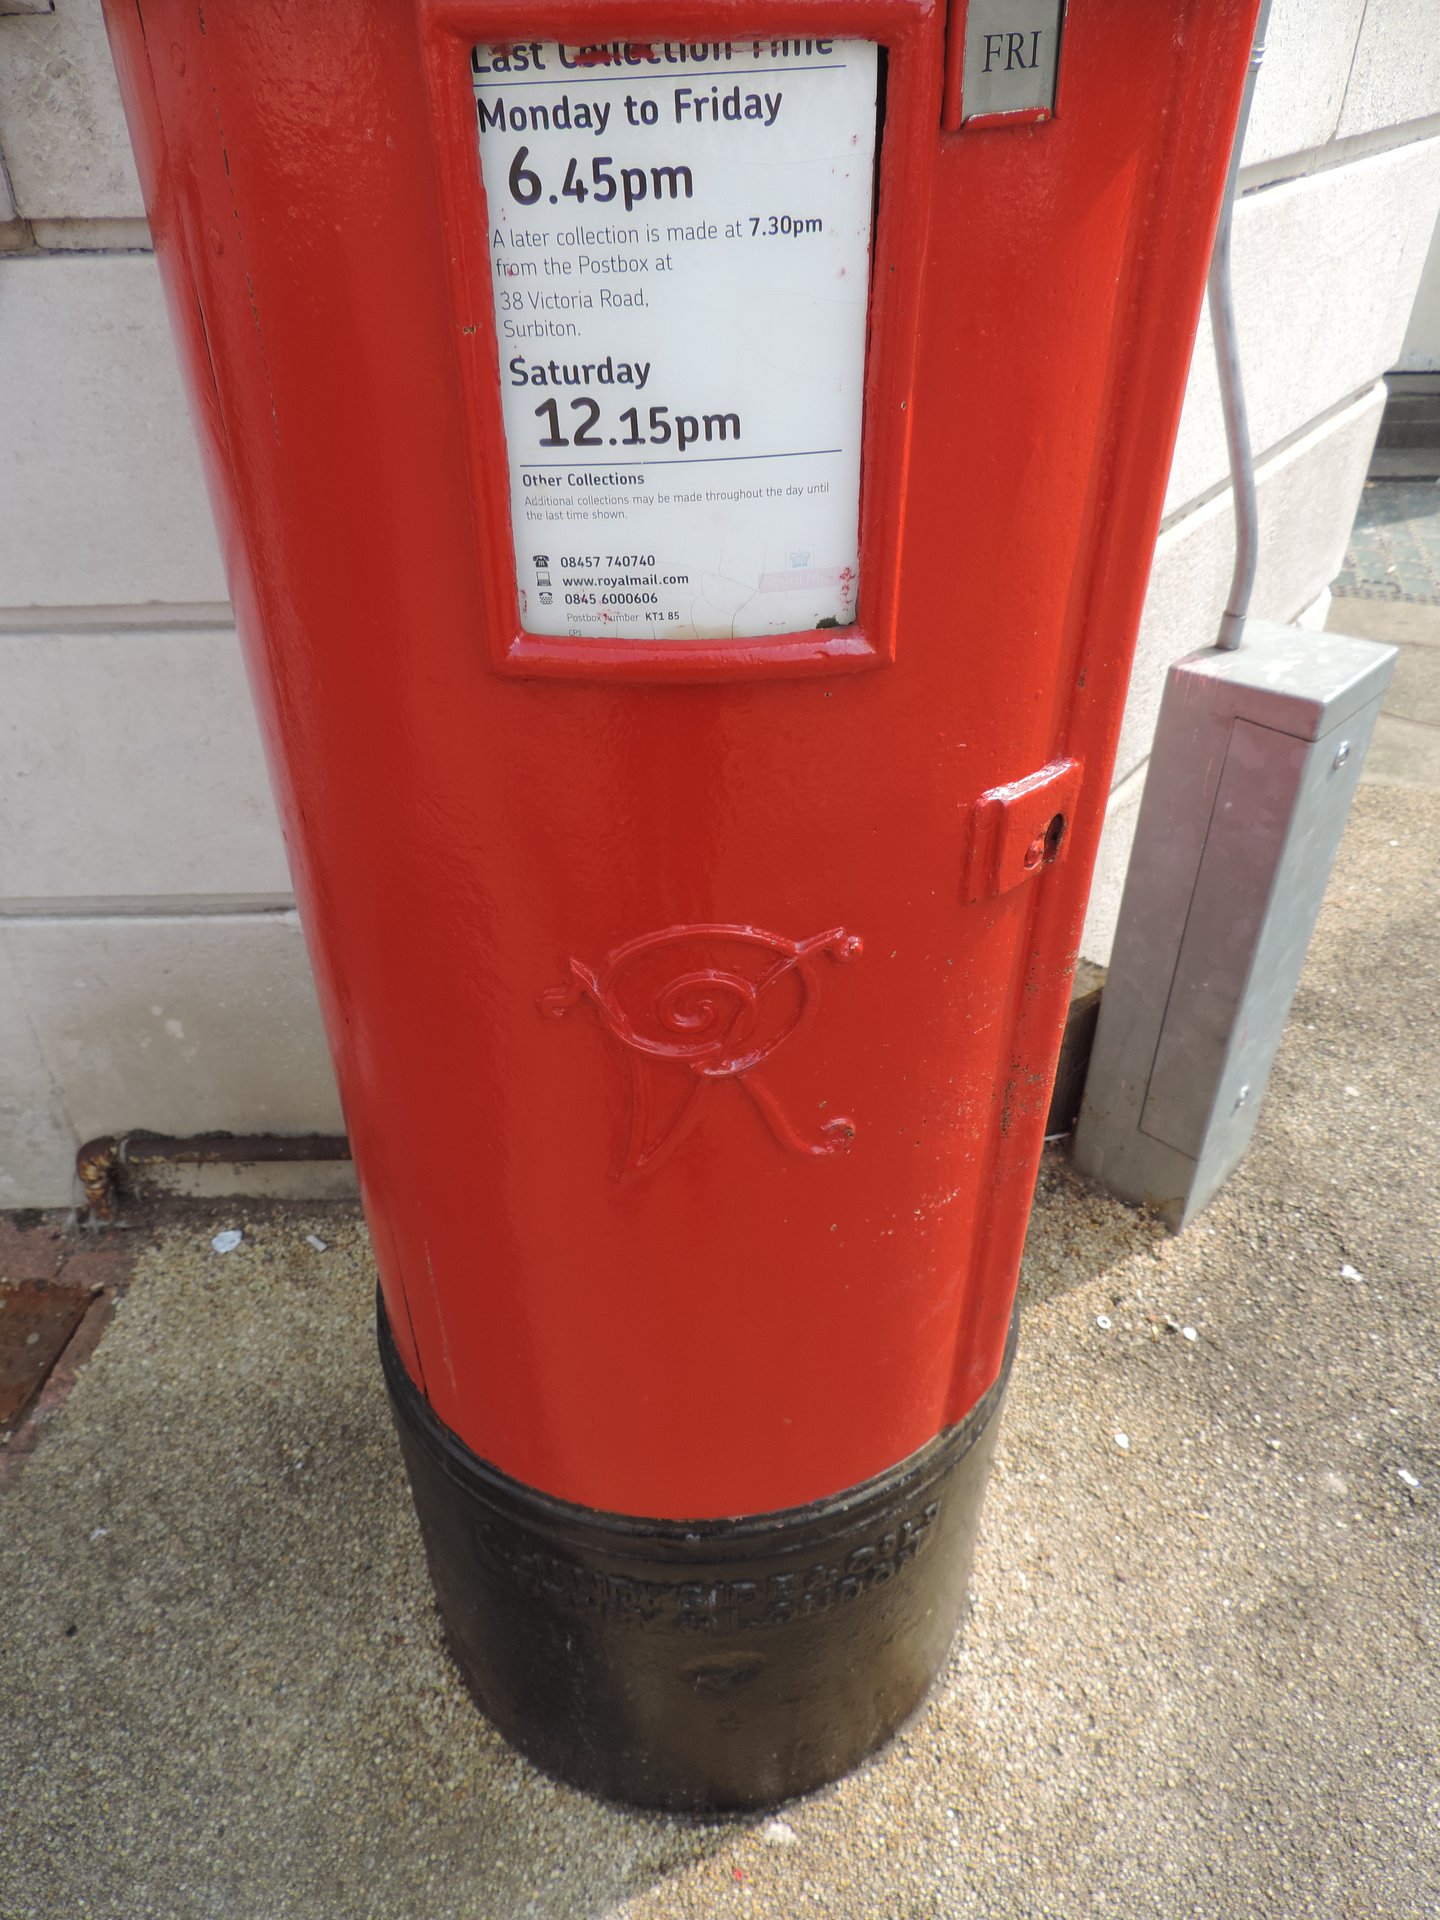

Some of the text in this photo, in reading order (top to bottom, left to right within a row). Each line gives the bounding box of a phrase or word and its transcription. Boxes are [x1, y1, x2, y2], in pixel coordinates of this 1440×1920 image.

[473, 44, 546, 73] Last
[559, 42, 732, 68] Cletion
[982, 31, 1041, 72] FRI
[478, 86, 782, 136] Monday to Friday
[509, 146, 693, 211] 6.45pm
[493, 216, 822, 248] A later collection is made at 7.30pm
[496, 254, 672, 277] from the Postbox at
[500, 288, 648, 310] 38 Victoria Road,
[504, 320, 580, 338] Surbiton.
[510, 355, 650, 389] Saturday
[535, 397, 740, 452] 12.15pm
[523, 472, 644, 486] Other Collections
[525, 482, 829, 506] Additional collections may be made throughout the day until
[526, 509, 628, 520] the last time shown.
[561, 555, 655, 567] 08457 740740
[563, 574, 688, 588] www.royalmail.com
[565, 593, 657, 604] 0845 6000606
[567, 612, 604, 622] Postbox
[646, 612, 664, 620] KT1
[668, 612, 679, 620] 85
